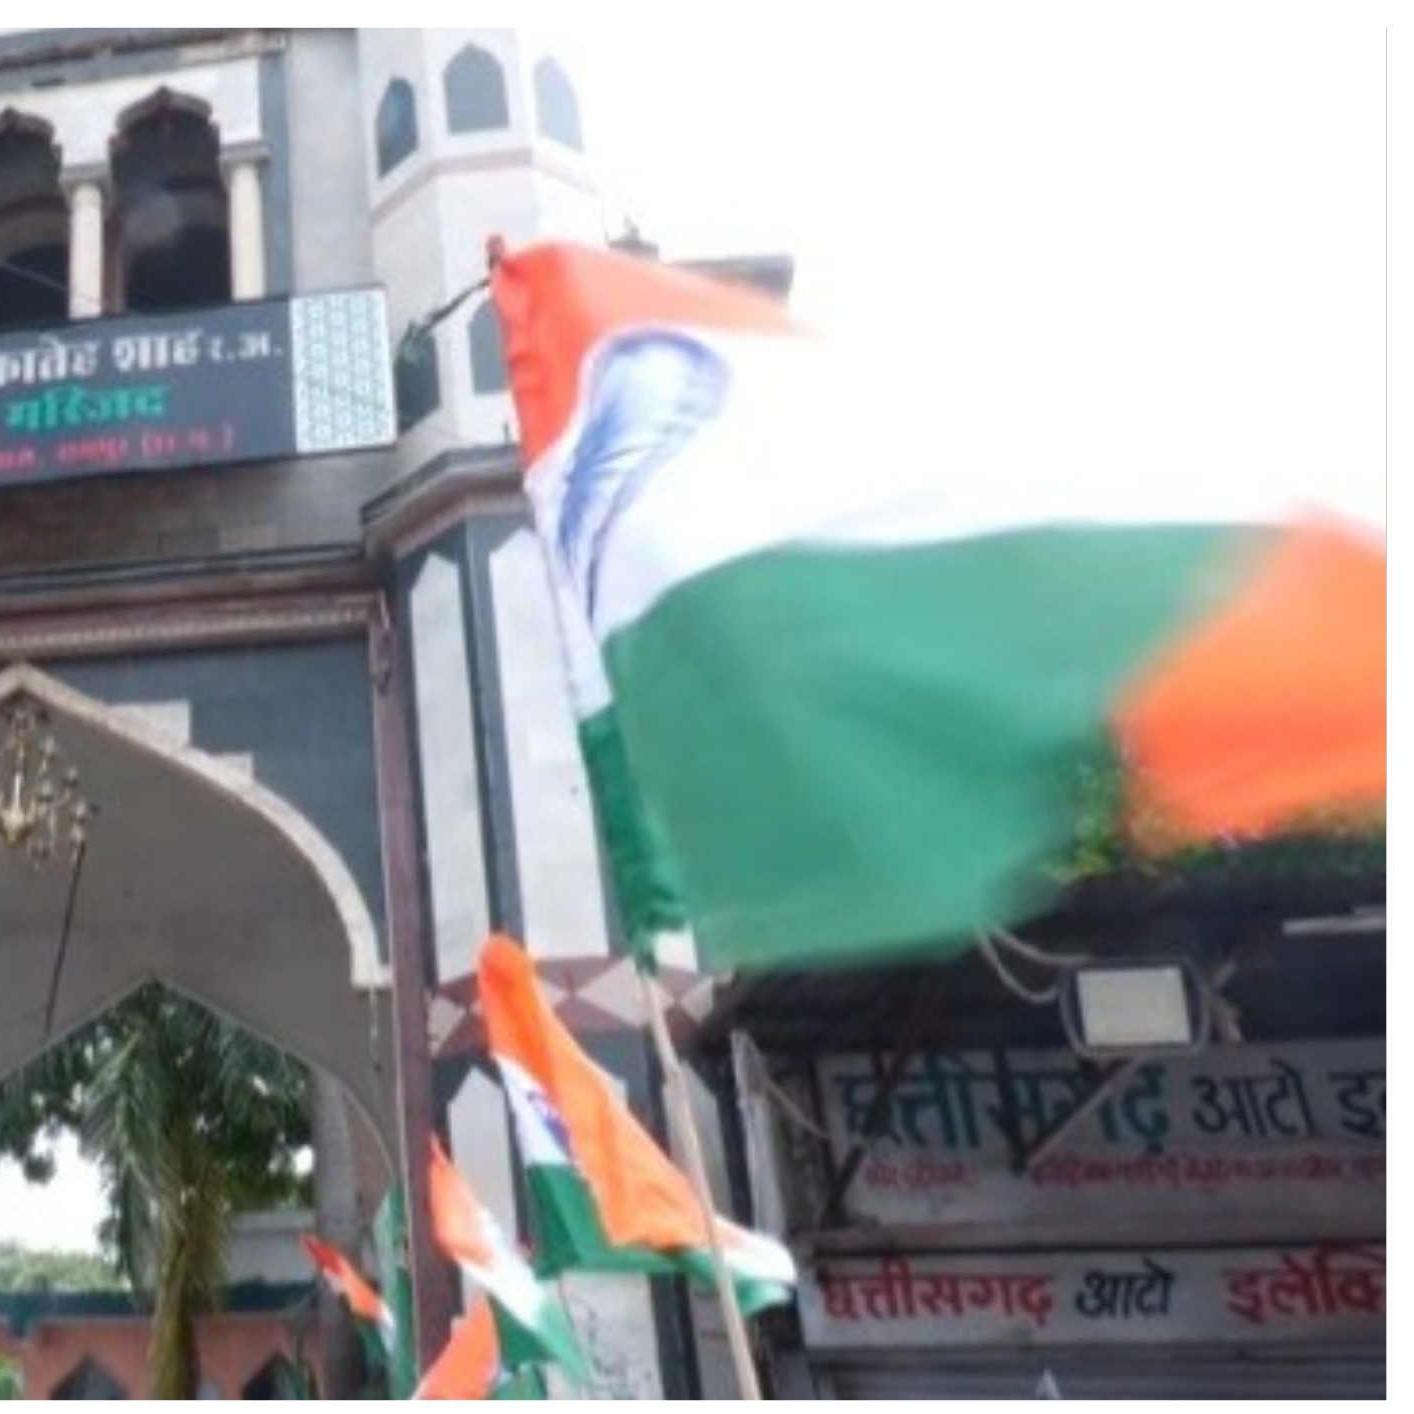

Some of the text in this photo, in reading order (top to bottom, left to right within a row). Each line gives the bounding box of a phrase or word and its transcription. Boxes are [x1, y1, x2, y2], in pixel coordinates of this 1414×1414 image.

[111, 327, 202, 372] शाह
[1328, 1068, 1386, 1139] इ
[1076, 1254, 1176, 1321] आटो
